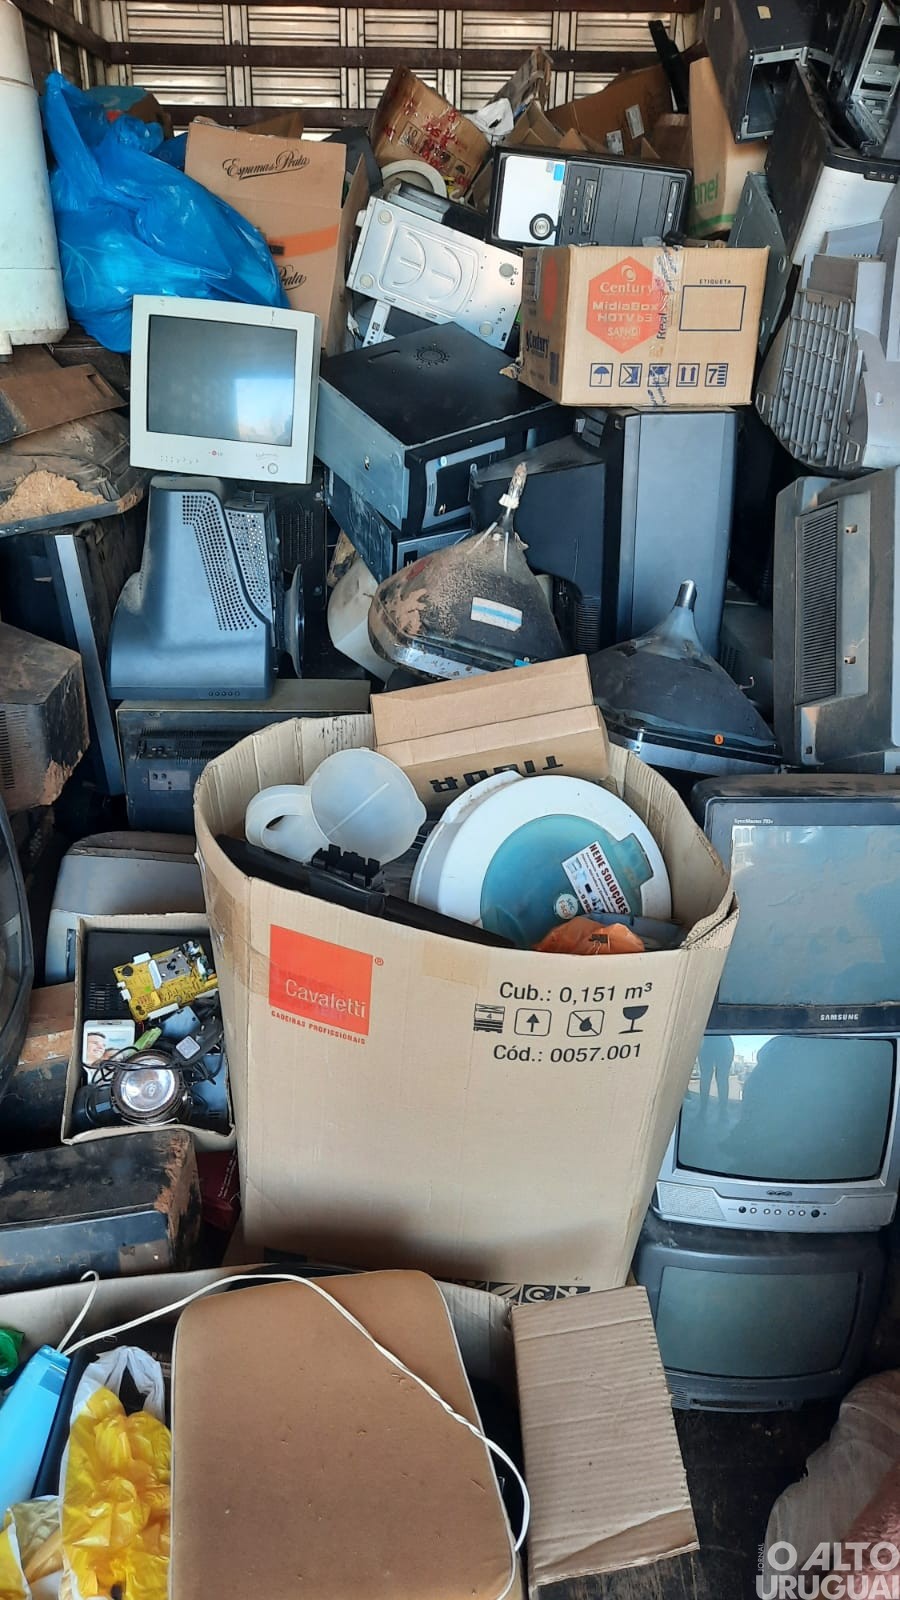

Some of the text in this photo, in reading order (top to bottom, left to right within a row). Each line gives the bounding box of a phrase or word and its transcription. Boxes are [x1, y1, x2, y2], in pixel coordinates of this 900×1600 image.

[600, 282, 653, 295] Century
[656, 312, 668, 339] Real
[601, 867, 629, 914] SOLUÇÕES
[285, 979, 367, 1018] Cavaletti
[500, 981, 552, 1001] Cub.:
[559, 985, 616, 1006] 0,151
[271, 1010, 366, 1045] CADEIRAS PROFISSIONAIS
[820, 1013, 859, 1021] SAMSUNG
[494, 1043, 641, 1063] Cód.: 0057.001
